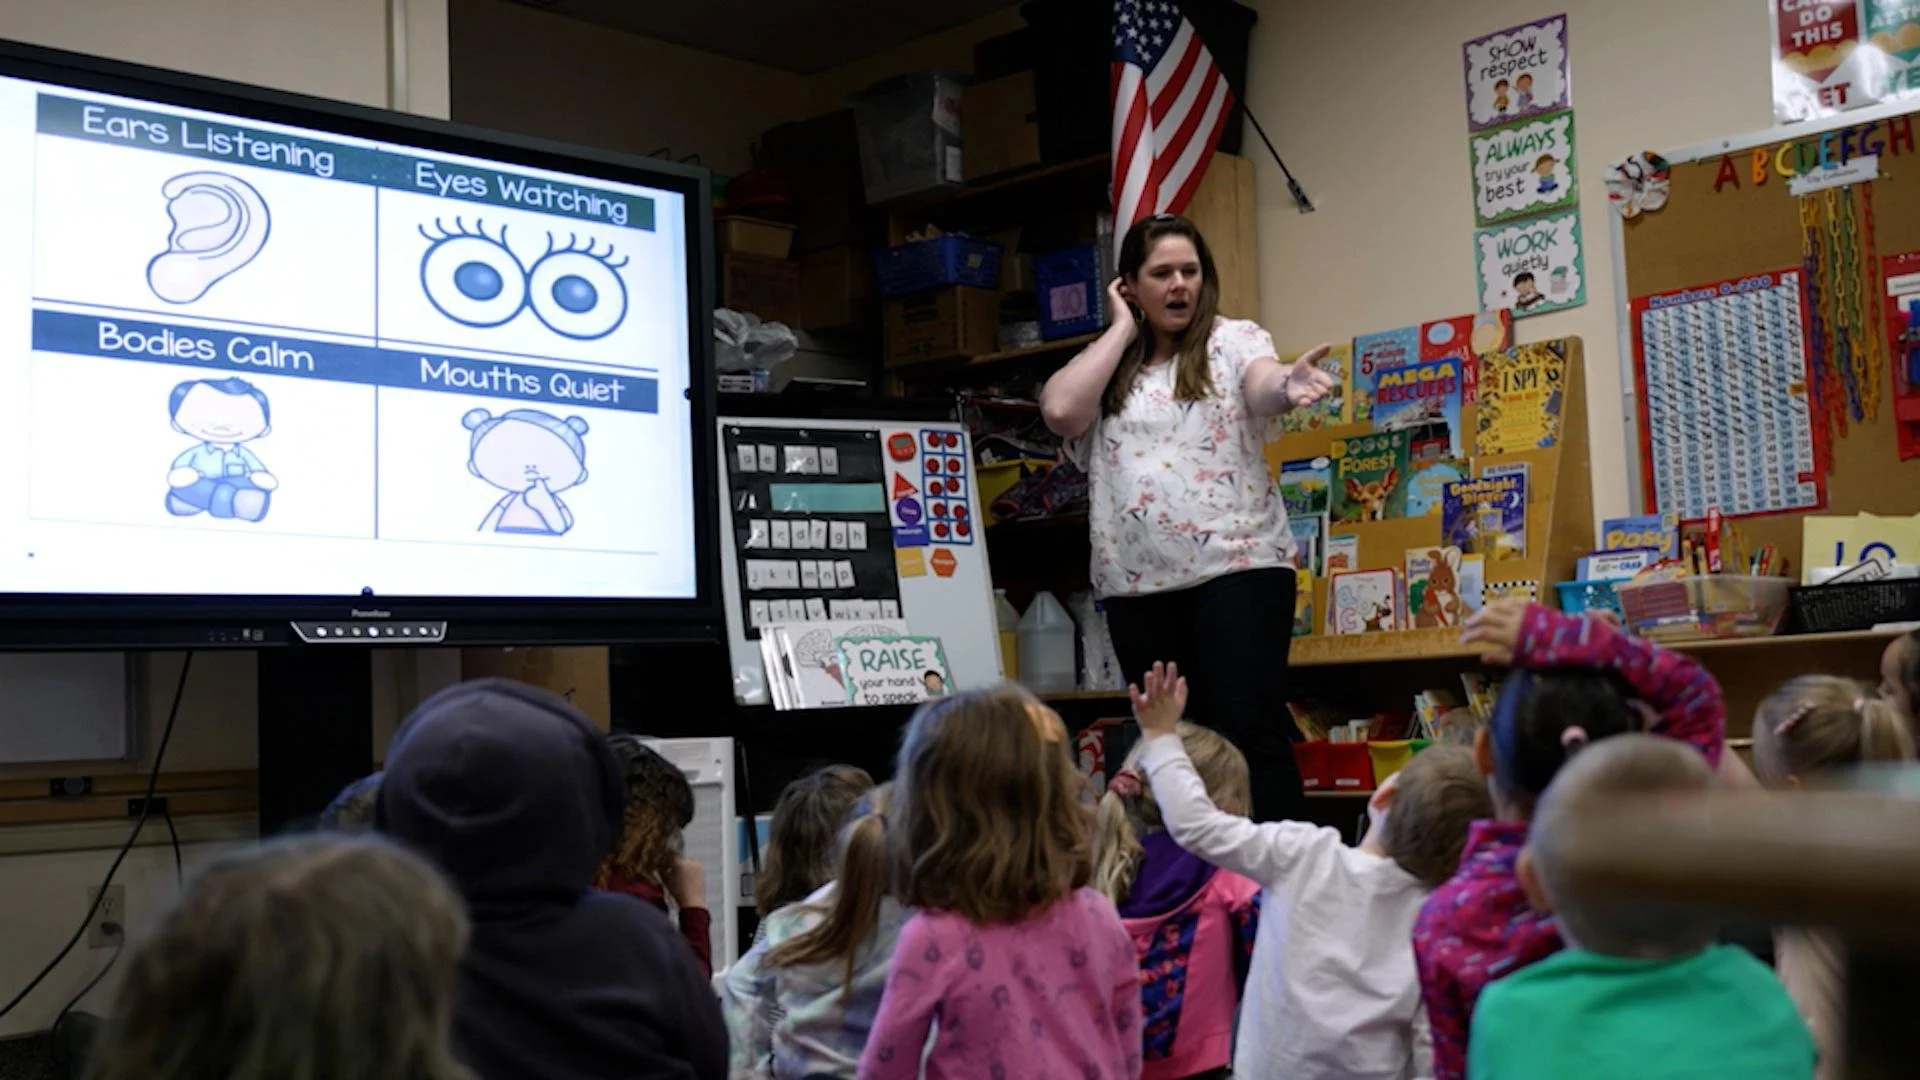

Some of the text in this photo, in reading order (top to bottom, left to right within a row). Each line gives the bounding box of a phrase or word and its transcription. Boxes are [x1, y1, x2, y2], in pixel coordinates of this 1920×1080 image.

[1799, 5, 1833, 27] DO
[1792, 21, 1844, 48] THIS
[1489, 35, 1537, 63] SHOW
[1480, 48, 1549, 81] respect
[1812, 81, 1851, 109] ET
[83, 106, 335, 178] Ears Listening
[1484, 127, 1556, 165] ALWAYS
[1485, 161, 1530, 183] try your
[415, 162, 628, 225] Eyes Watching
[1485, 178, 1525, 203] best
[1497, 227, 1559, 259] WORK
[1502, 253, 1550, 277] quietly
[98, 323, 314, 372] Bodies Calm
[1361, 352, 1374, 376] 5
[1378, 362, 1457, 389] MEGA
[420, 358, 625, 404] Mouths Quiet
[1377, 376, 1456, 405] RESCUERS
[1503, 367, 1540, 393] I SPY
[1339, 450, 1397, 479] FOREST
[860, 647, 926, 672] RAISE
[860, 676, 916, 690] your hand
[864, 690, 918, 705] to speak
